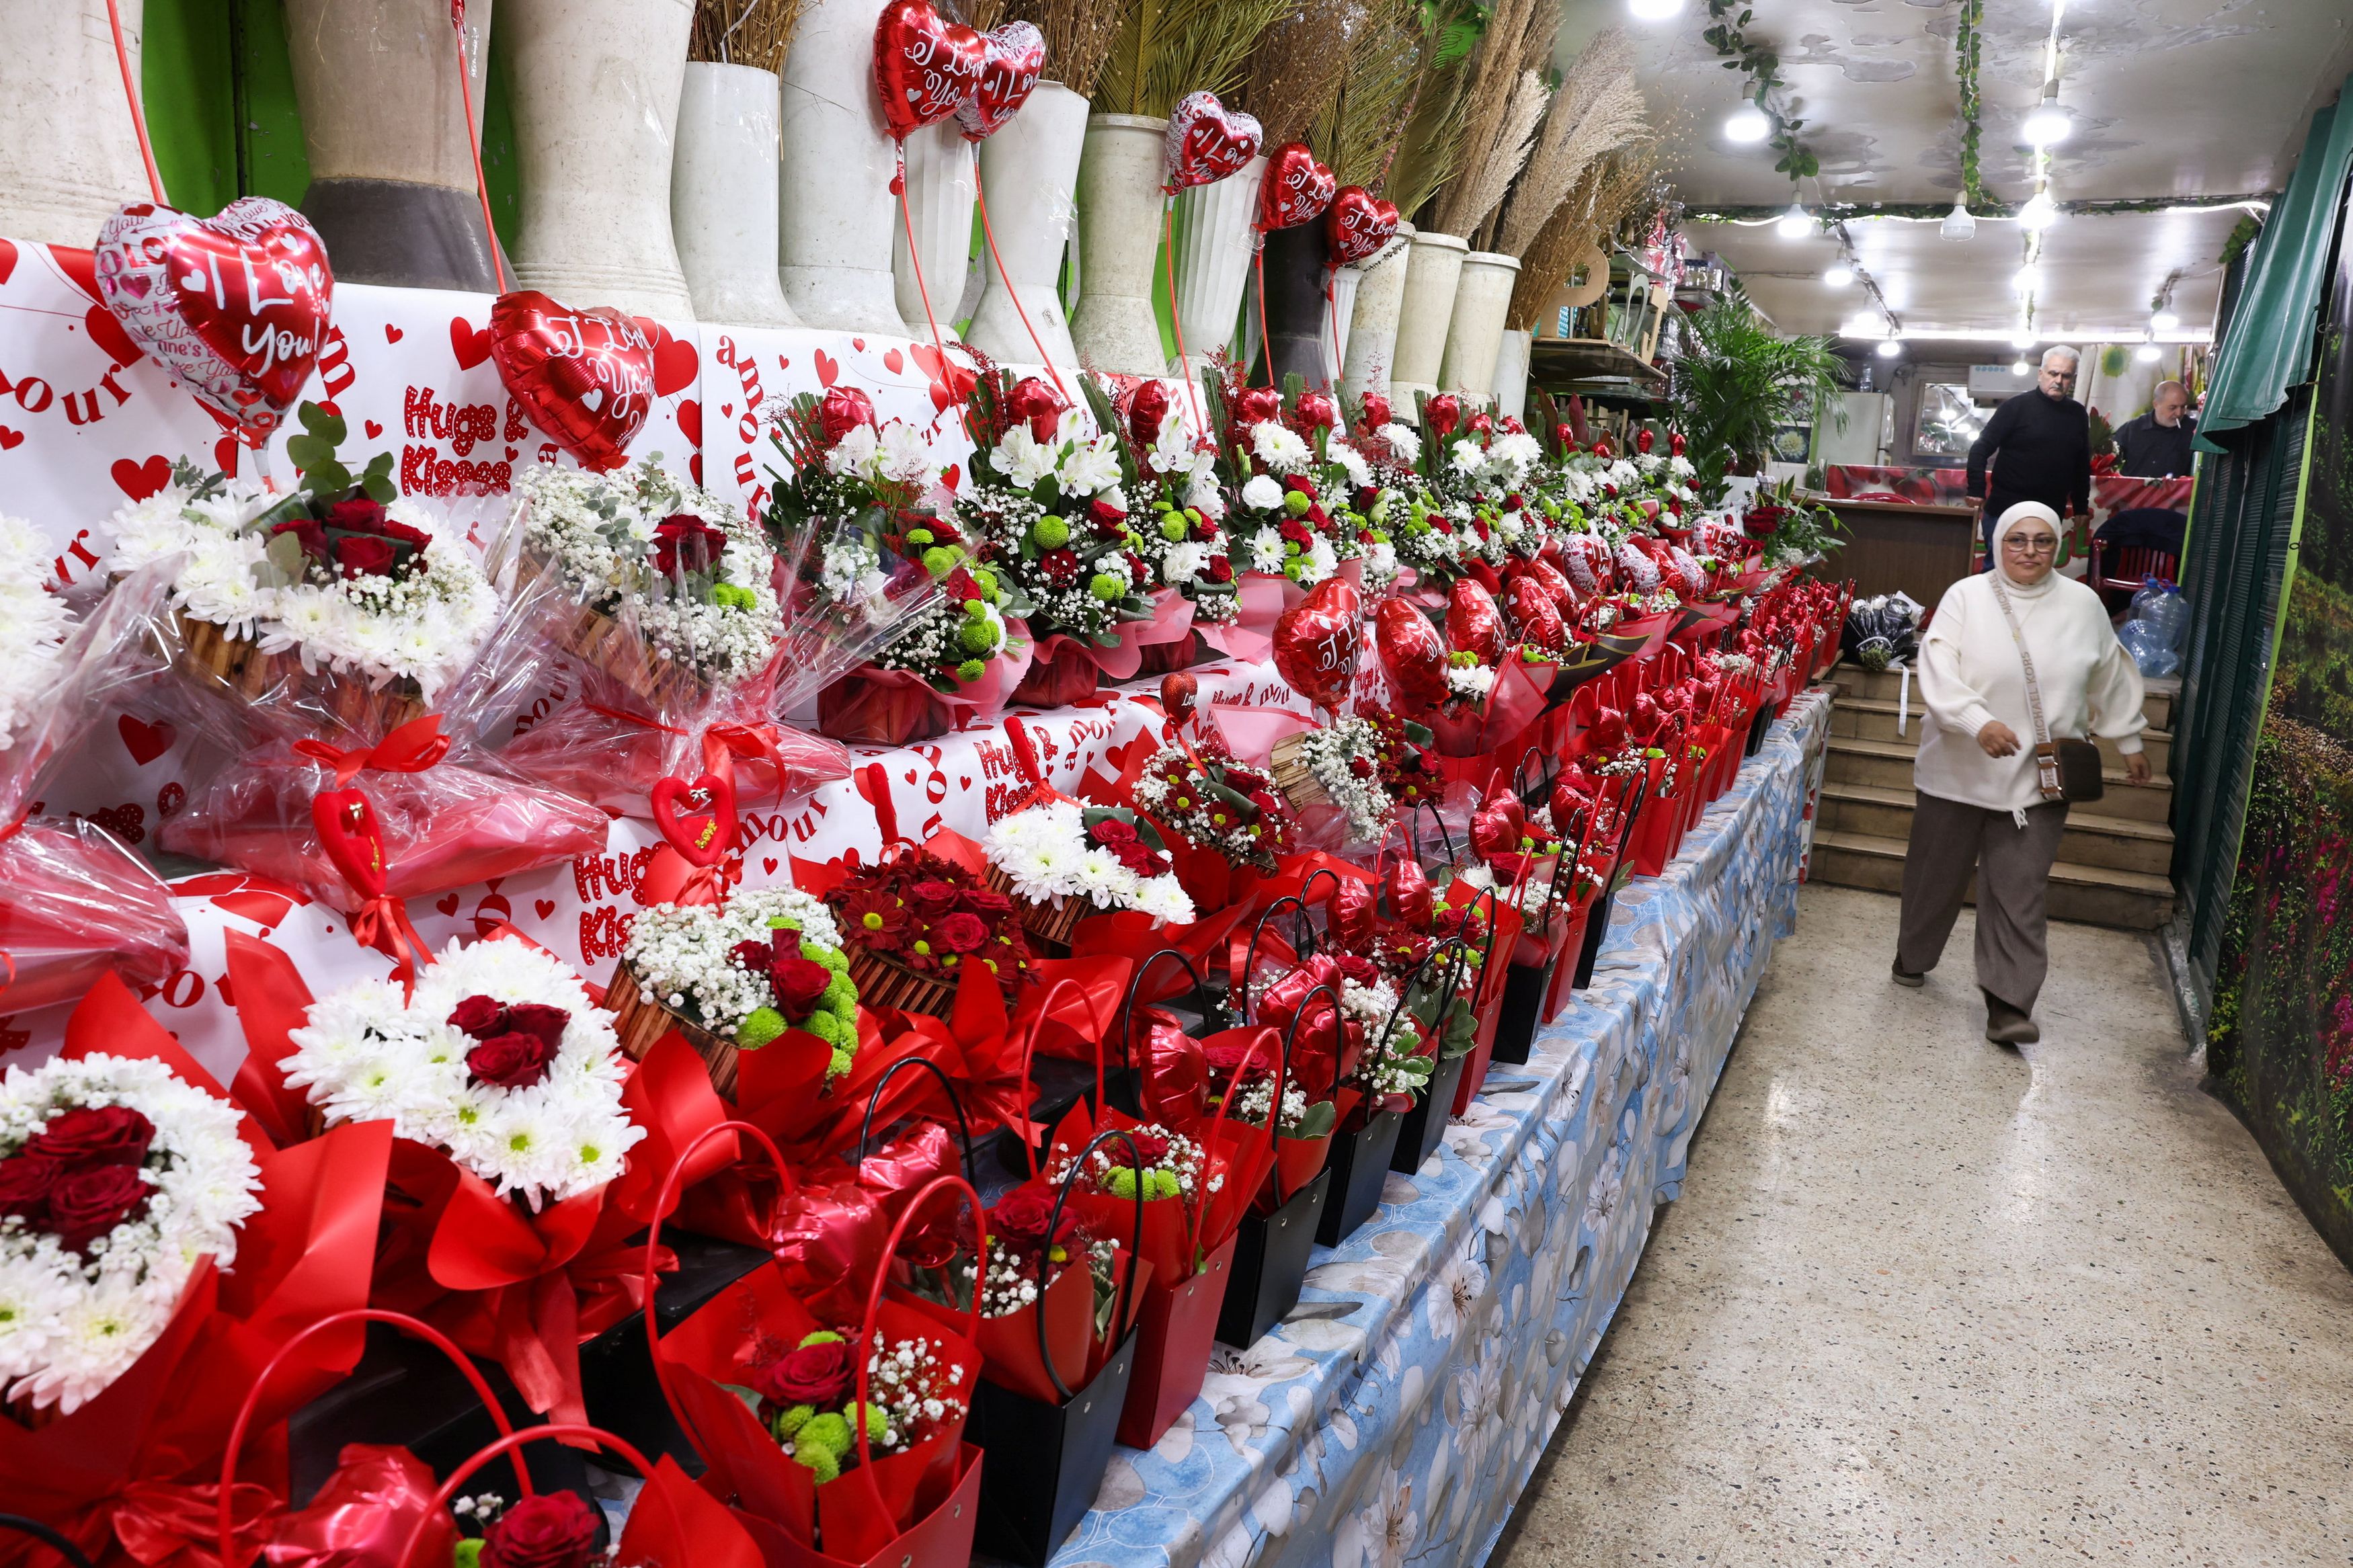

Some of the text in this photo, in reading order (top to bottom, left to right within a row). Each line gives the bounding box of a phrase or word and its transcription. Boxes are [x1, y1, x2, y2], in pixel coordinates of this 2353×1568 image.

[239, 246, 325, 317] Love
[0, 363, 132, 425] our
[403, 384, 497, 457] Hugs
[401, 444, 512, 497] Kisses
[1181, 692, 1198, 707] Lov
[724, 792, 828, 858] mour
